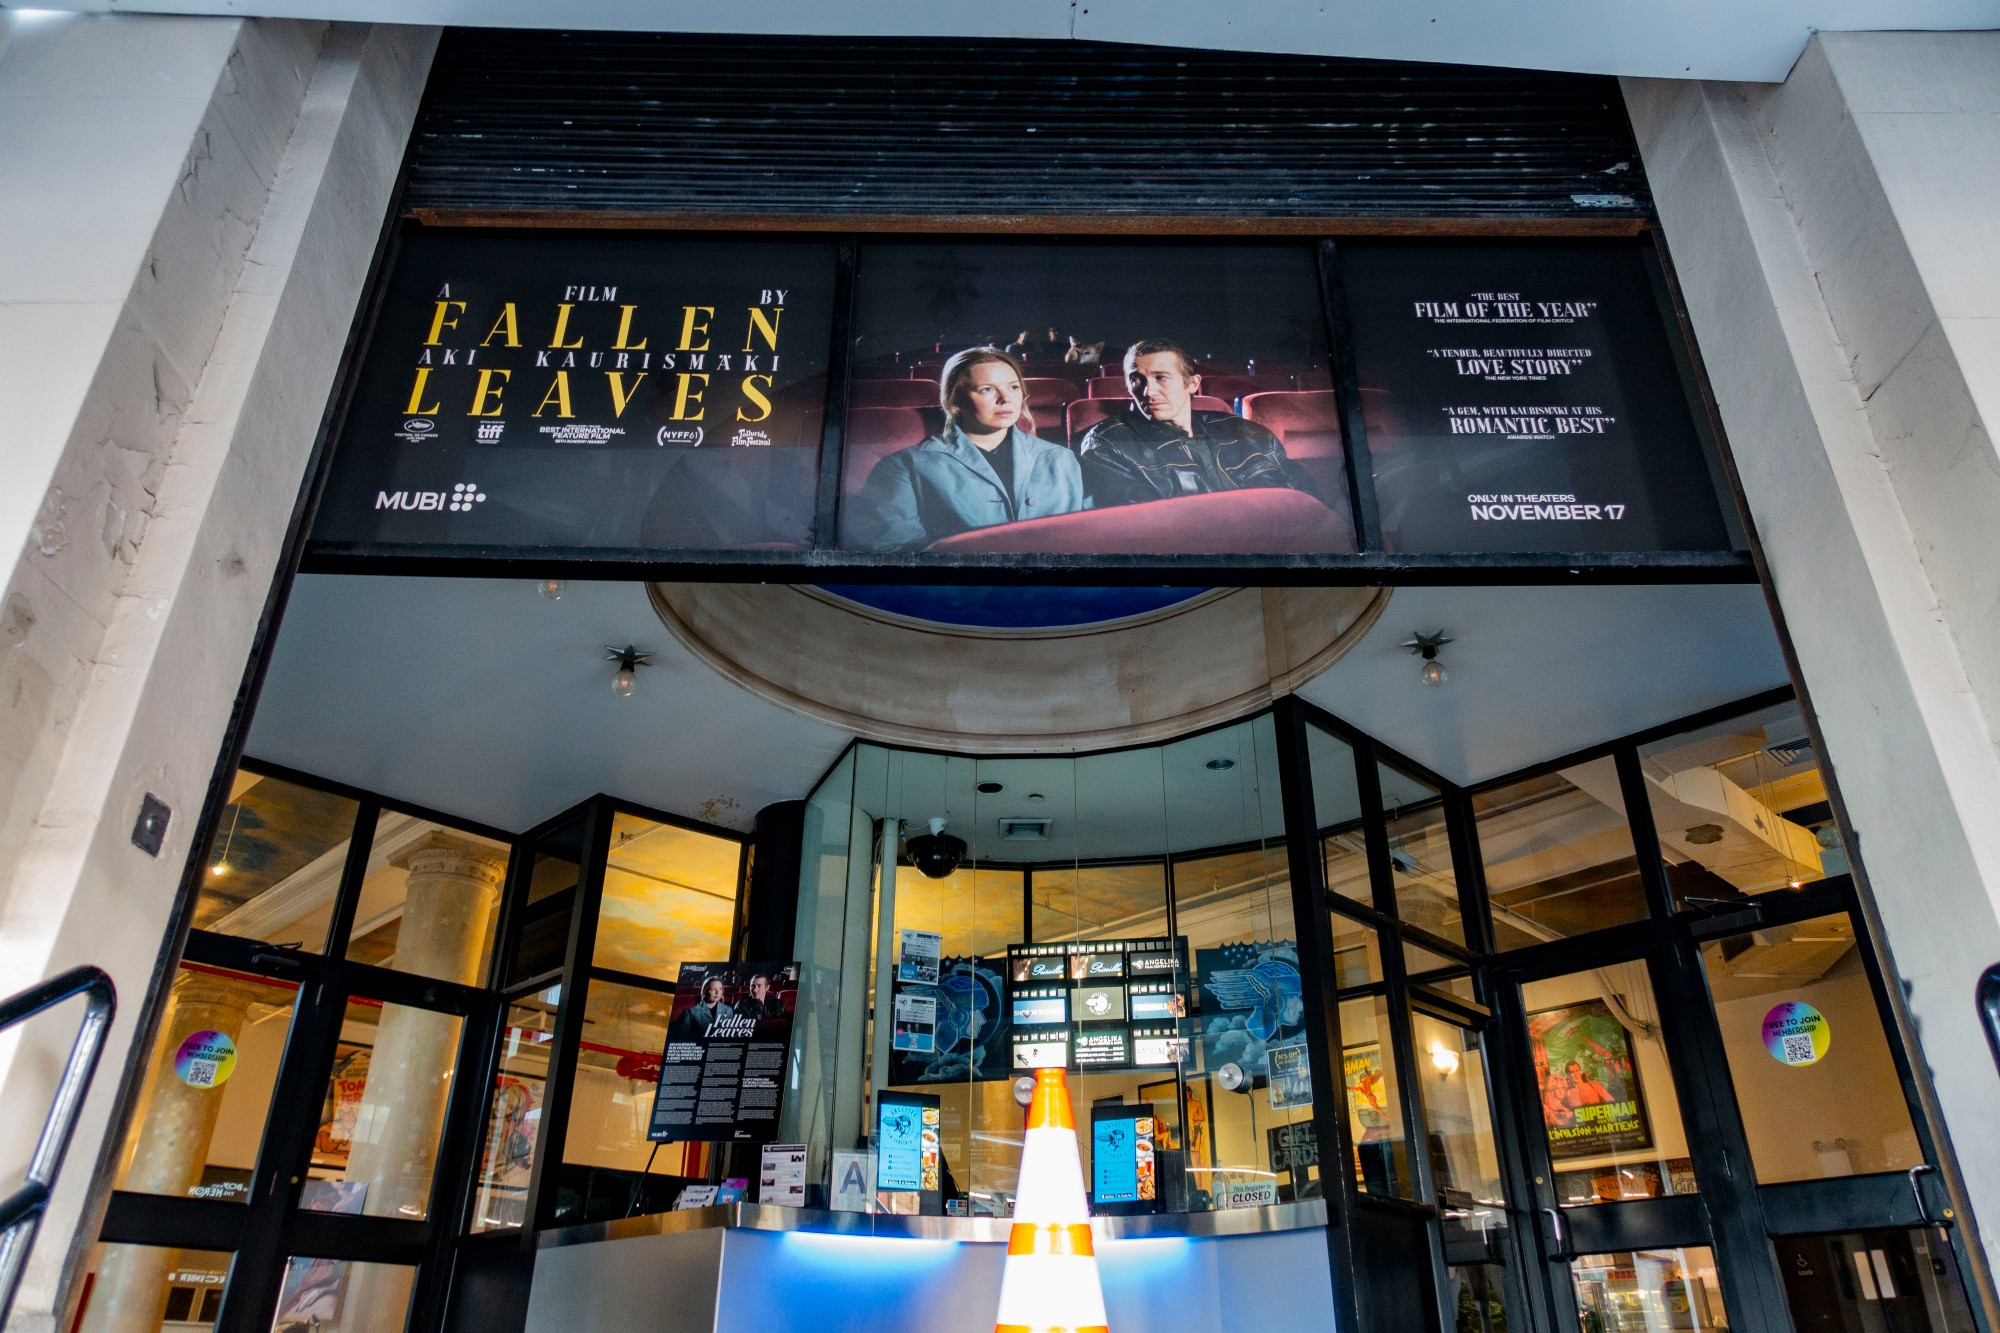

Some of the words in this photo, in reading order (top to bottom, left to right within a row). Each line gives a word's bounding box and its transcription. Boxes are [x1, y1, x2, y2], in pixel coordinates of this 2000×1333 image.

[437, 283, 450, 298] A
[564, 285, 617, 302] FILM
[760, 289, 789, 305] BY
[1497, 292, 1520, 301] BEST
[1414, 302, 1459, 318] FILM
[1465, 302, 1489, 318] OF
[1493, 302, 1533, 318] THE
[422, 301, 785, 352] FALLEN
[418, 348, 477, 366] AKI
[535, 350, 781, 372] KAURISMÄKI
[1483, 349, 1545, 358] BEAUTIFULLY
[1547, 349, 1592, 358] DIRECTED
[1456, 359, 1506, 375] LOVE
[402, 367, 773, 422] LEAVES
[1483, 406, 1508, 416] WITH
[1571, 406, 1582, 416] AT
[1585, 406, 1602, 416] HIS
[478, 424, 505, 439] tiff
[561, 427, 626, 435] INTERNATIONAL
[1449, 417, 1550, 434] ROMANTIC
[375, 490, 447, 511] MUBI
[1467, 494, 1498, 503] ONLY
[1500, 494, 1513, 503] IN
[1515, 494, 1576, 503] THEATERS
[1470, 504, 1603, 520] NOVEMBER
[1604, 504, 1625, 520] 17
[713, 1014, 756, 1028] Fallen
[1764, 1020, 1784, 1030] FREE
[1786, 1018, 1797, 1026] TO
[1800, 1015, 1821, 1024] JOIN
[703, 1023, 754, 1038] Leaves
[1772, 1024, 1817, 1037] MEMBERSHIP
[186, 1052, 227, 1062] MEMBERSHIP
[215, 1047, 234, 1055] JOIN
[1574, 1101, 1637, 1123] SUPERMAN
[1594, 1120, 1640, 1135] MARTIENS
[839, 1160, 867, 1194] A
[1232, 1191, 1271, 1203] CLOSED
